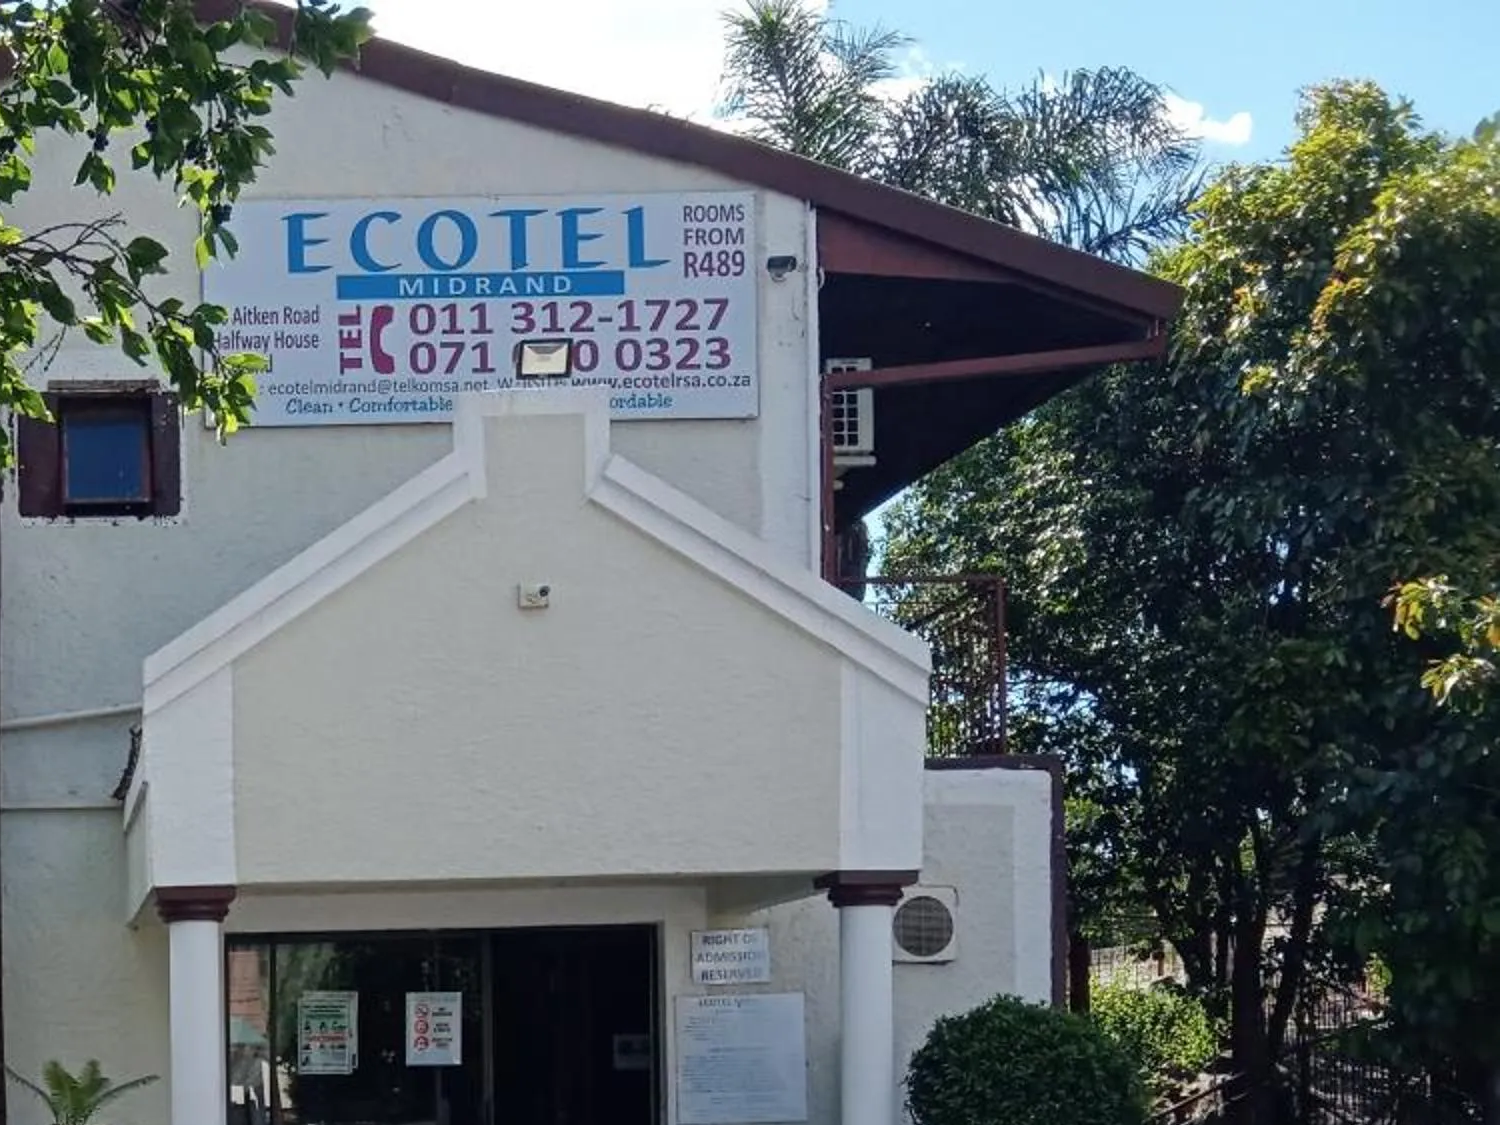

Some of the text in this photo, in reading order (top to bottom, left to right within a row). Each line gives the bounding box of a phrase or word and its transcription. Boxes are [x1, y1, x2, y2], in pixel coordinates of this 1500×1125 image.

[683, 205, 745, 223] ROOMS
[280, 206, 671, 273] ECOTEL
[683, 228, 745, 246] FROM
[683, 250, 745, 278] R489
[399, 275, 571, 296] MIDRAND
[232, 306, 279, 326] Aitken
[283, 304, 320, 325] Road
[409, 298, 729, 336] 011 312-1727
[274, 330, 320, 350] House
[338, 305, 363, 375] TEL
[409, 340, 496, 375] 071
[615, 336, 731, 372] 0323
[285, 395, 453, 414] Clean Comfortable
[609, 393, 673, 409] ordable
[702, 932, 739, 945] RIGHT
